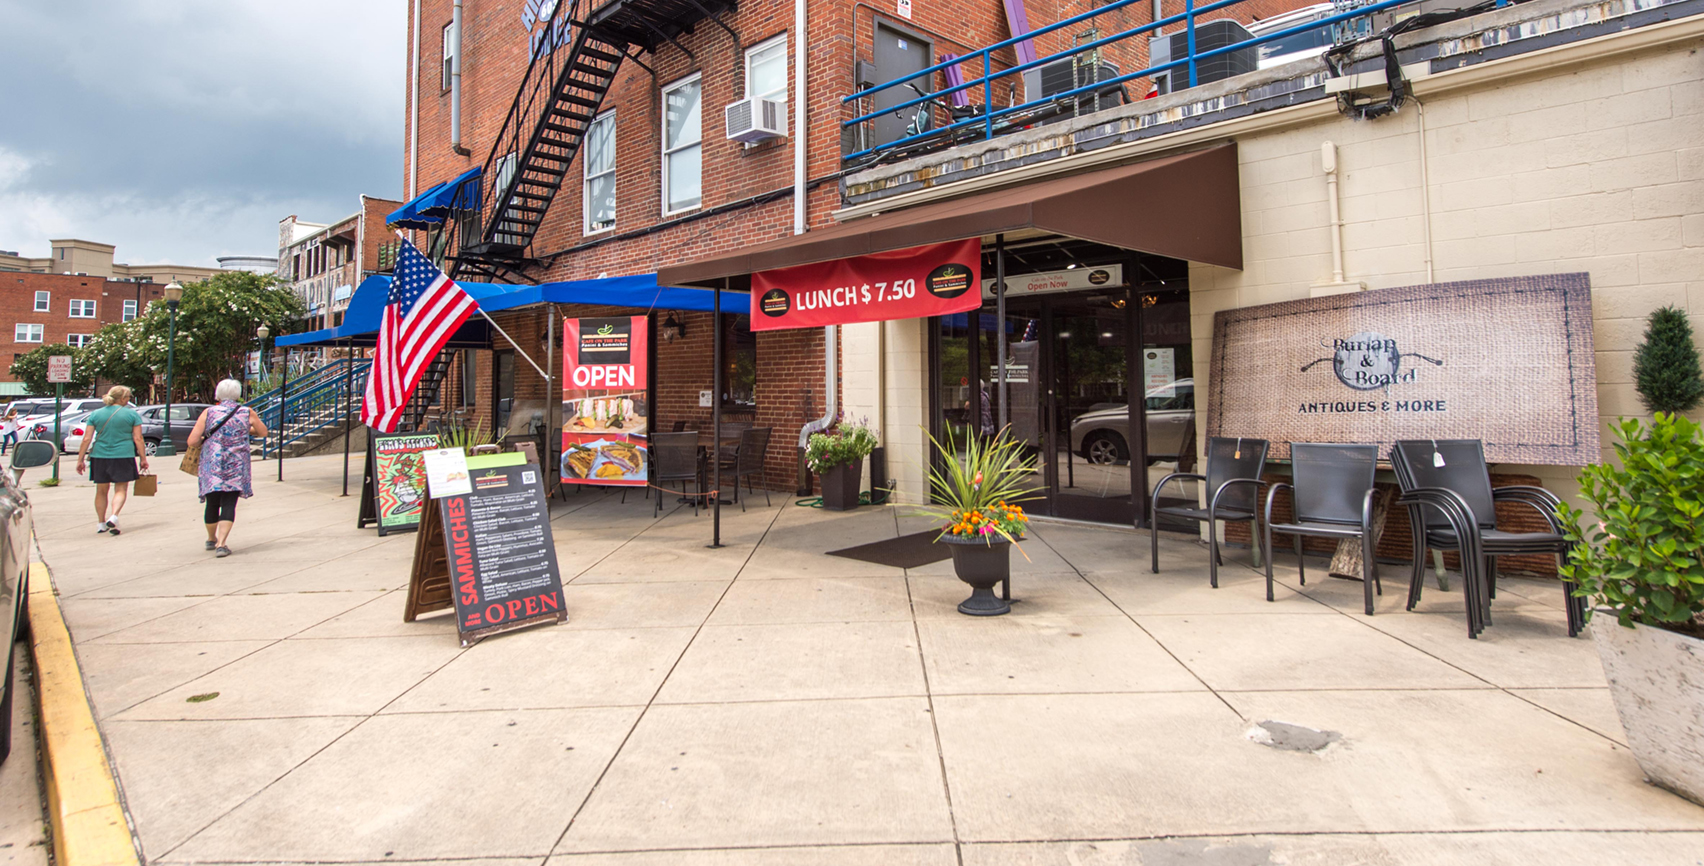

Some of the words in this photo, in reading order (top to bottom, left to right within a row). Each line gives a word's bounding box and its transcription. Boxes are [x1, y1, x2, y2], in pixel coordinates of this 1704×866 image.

[796, 286, 857, 310] LUNCH
[861, 283, 871, 304] $
[875, 278, 915, 301] 7.50
[1028, 283, 1048, 292] Open
[1321, 337, 1396, 353] Burlap
[1360, 354, 1374, 368] &
[573, 365, 634, 387] OPEN
[1343, 367, 1417, 385] Board
[1299, 402, 1377, 413] ANTIQUES
[1396, 400, 1446, 412] MORE
[448, 498, 478, 605] SAMMICHES
[485, 592, 558, 623] OPEN
